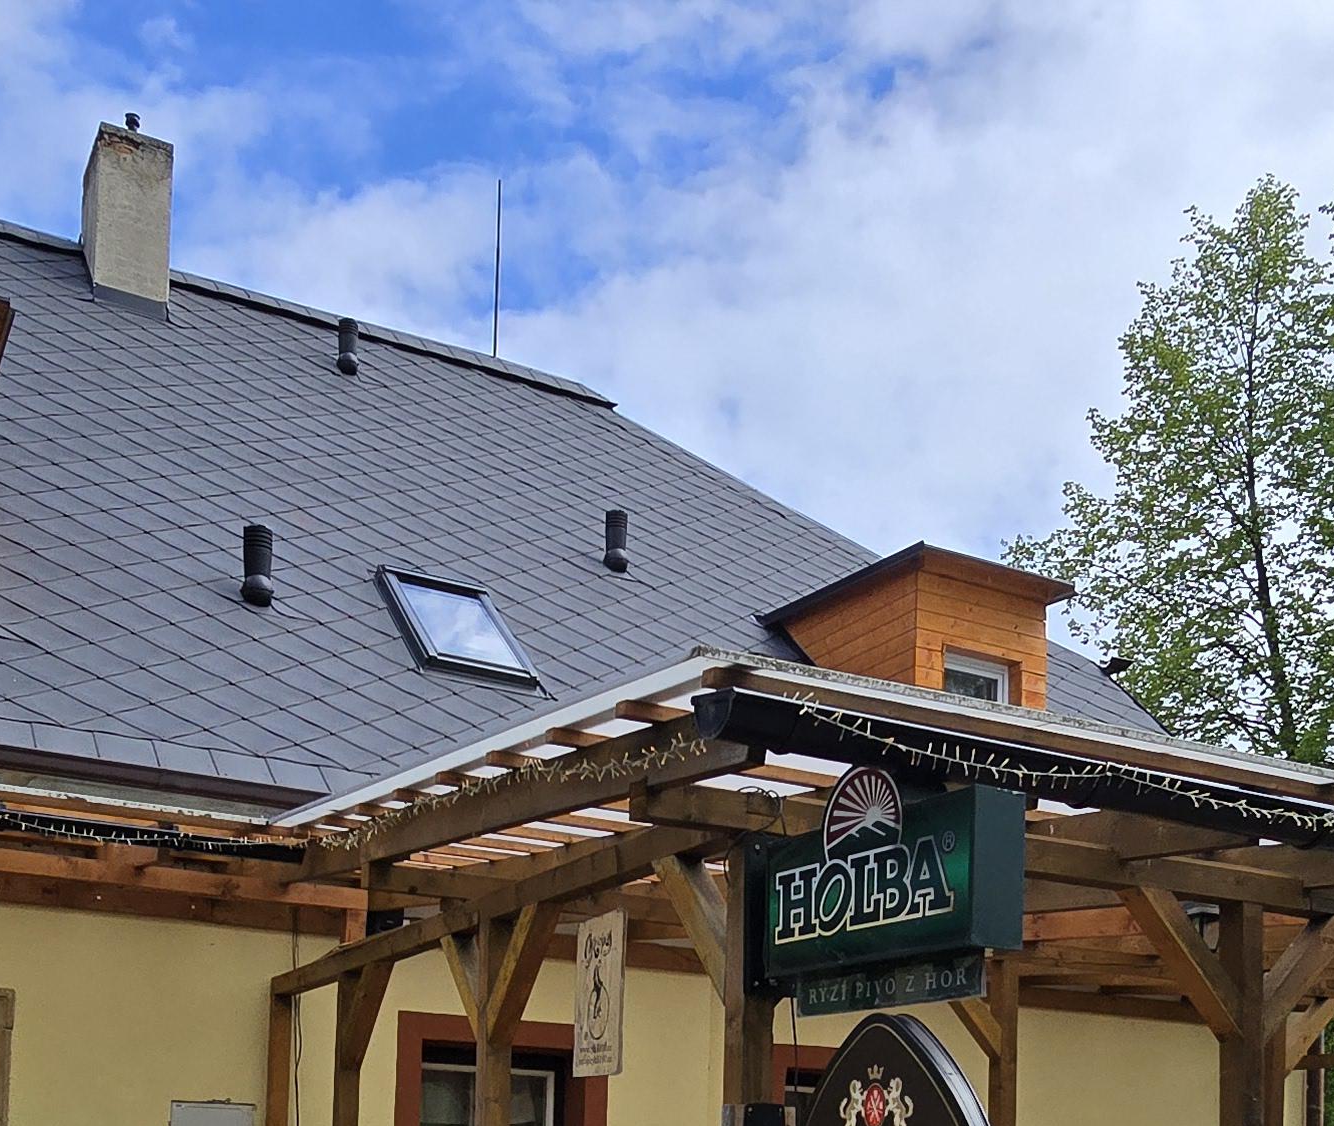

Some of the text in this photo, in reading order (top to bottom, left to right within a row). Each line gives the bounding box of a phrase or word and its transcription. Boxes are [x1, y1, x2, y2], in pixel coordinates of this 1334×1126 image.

[775, 835, 954, 944] HOLBA
[855, 978, 897, 999] PIVO
[905, 975, 916, 993] Z
[925, 967, 967, 990] HOR
